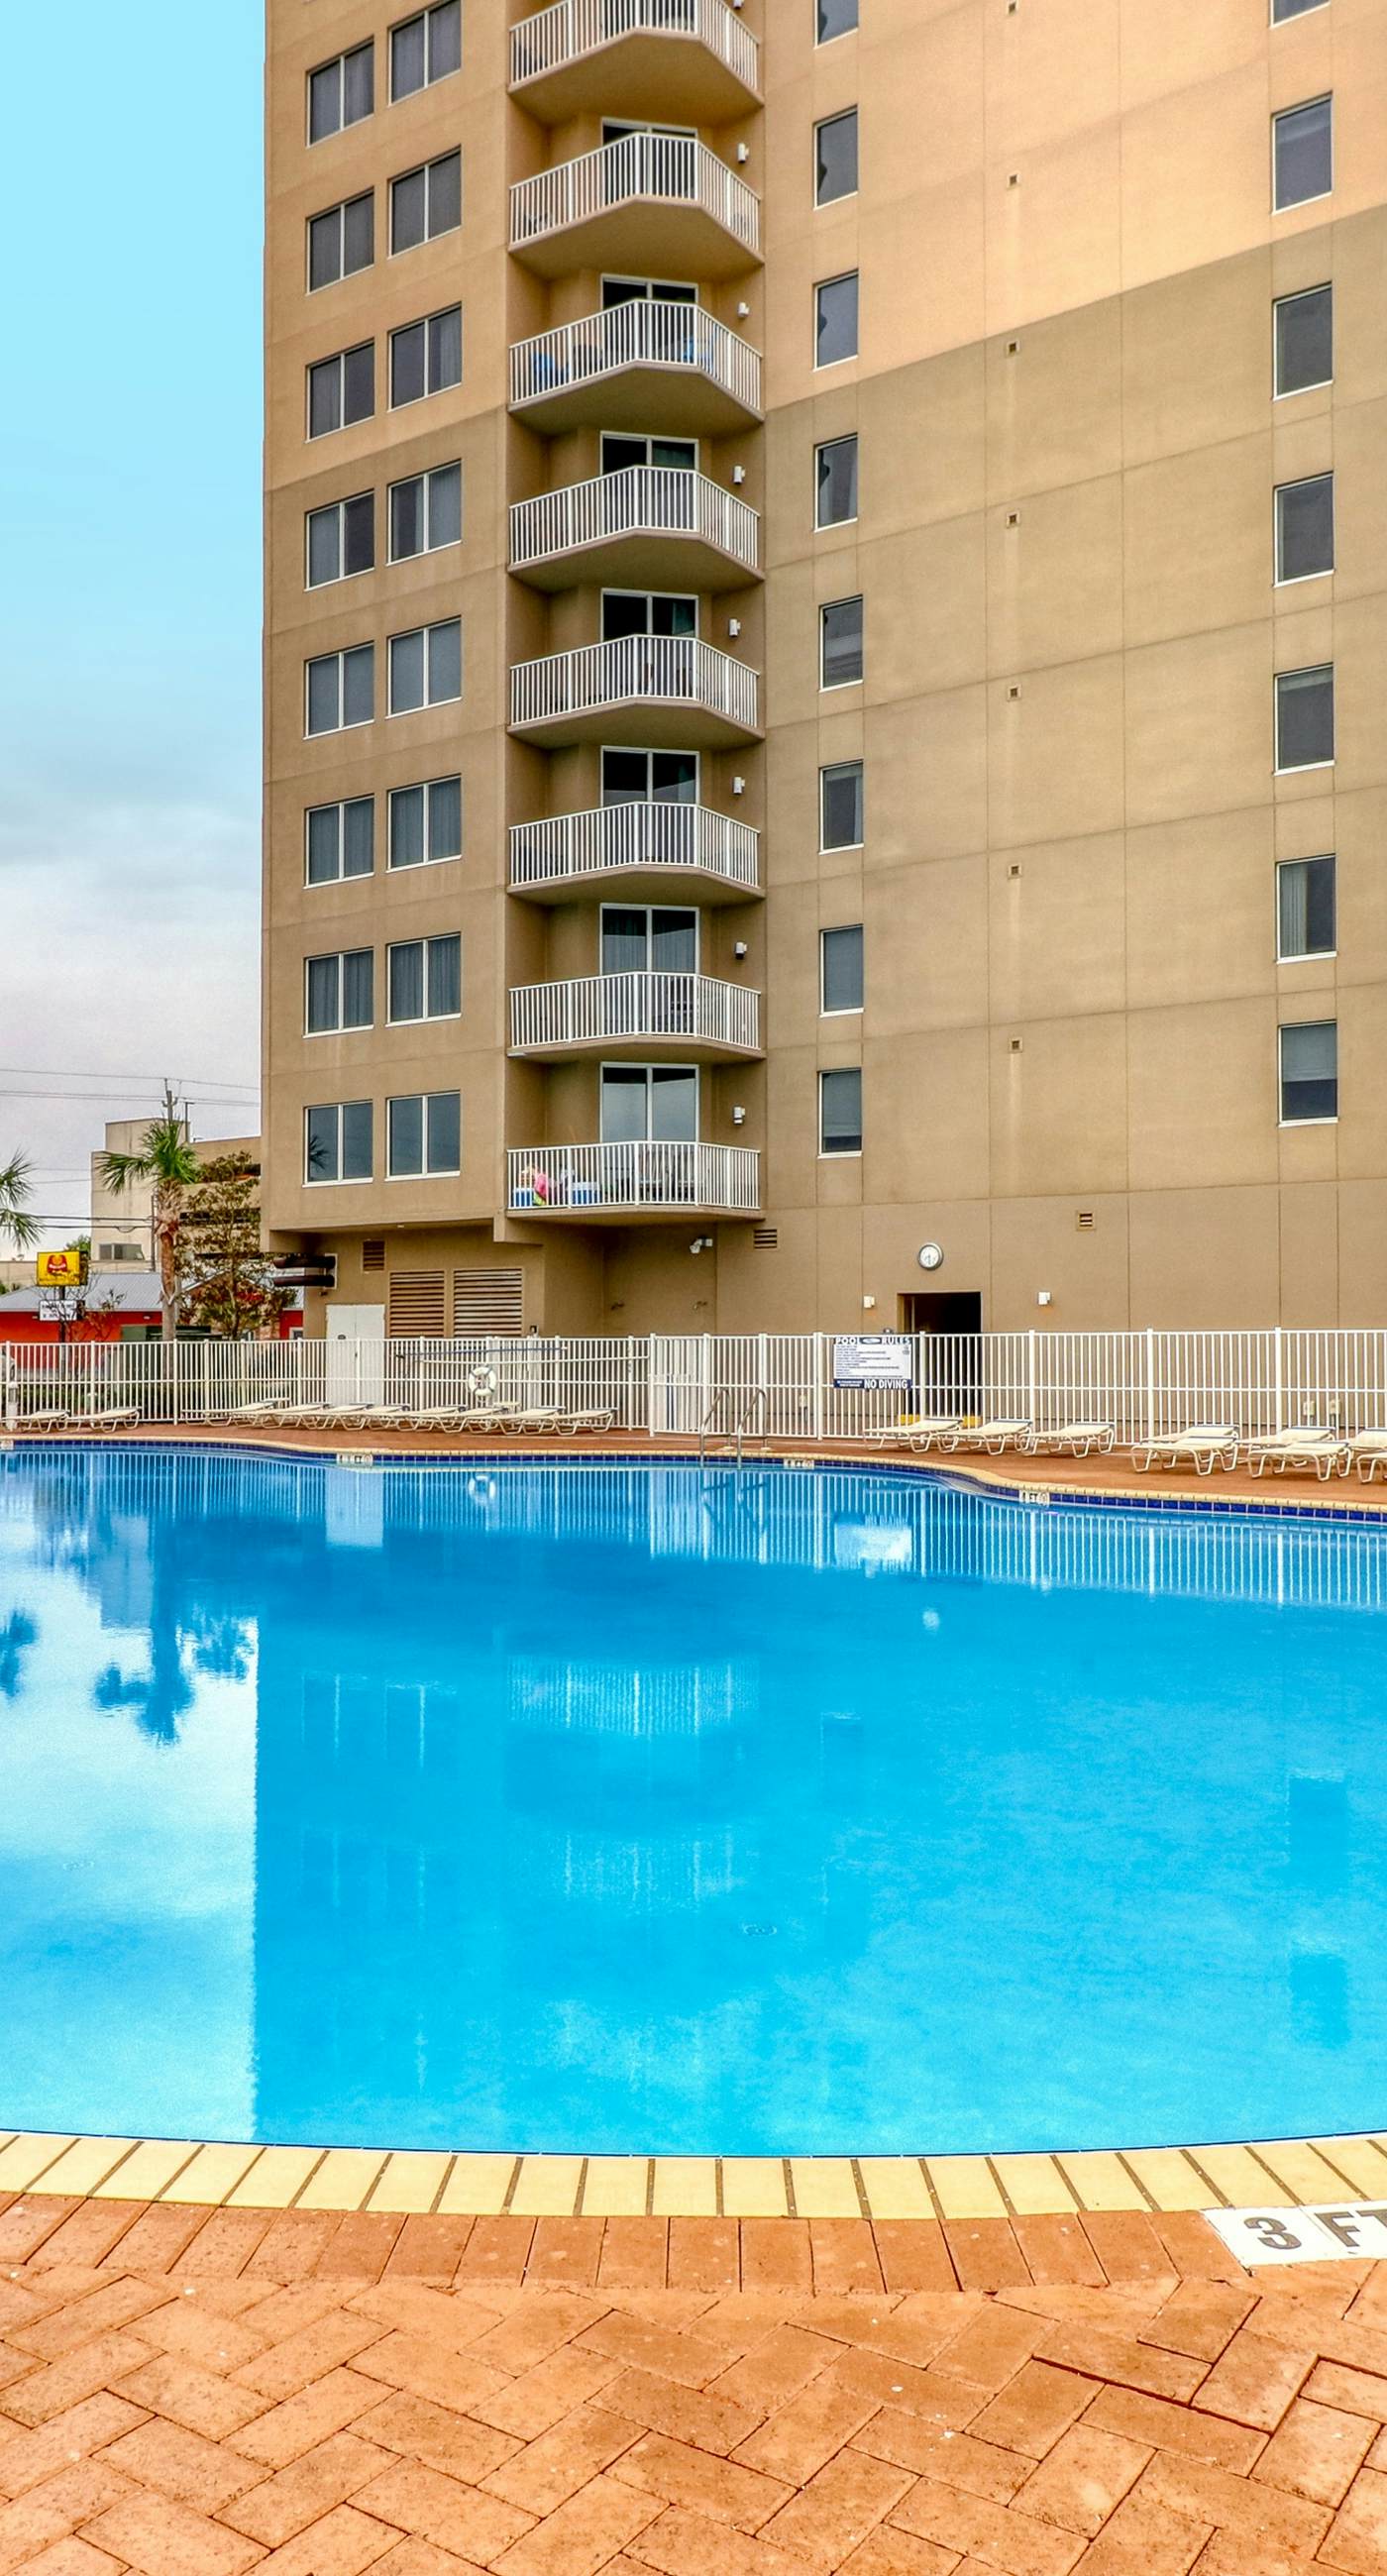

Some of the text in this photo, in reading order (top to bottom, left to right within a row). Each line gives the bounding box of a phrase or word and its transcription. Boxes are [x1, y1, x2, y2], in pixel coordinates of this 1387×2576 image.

[864, 1379, 877, 1389] NO
[878, 1379, 907, 1389] DIVING
[1244, 2217, 1302, 2250] 3
